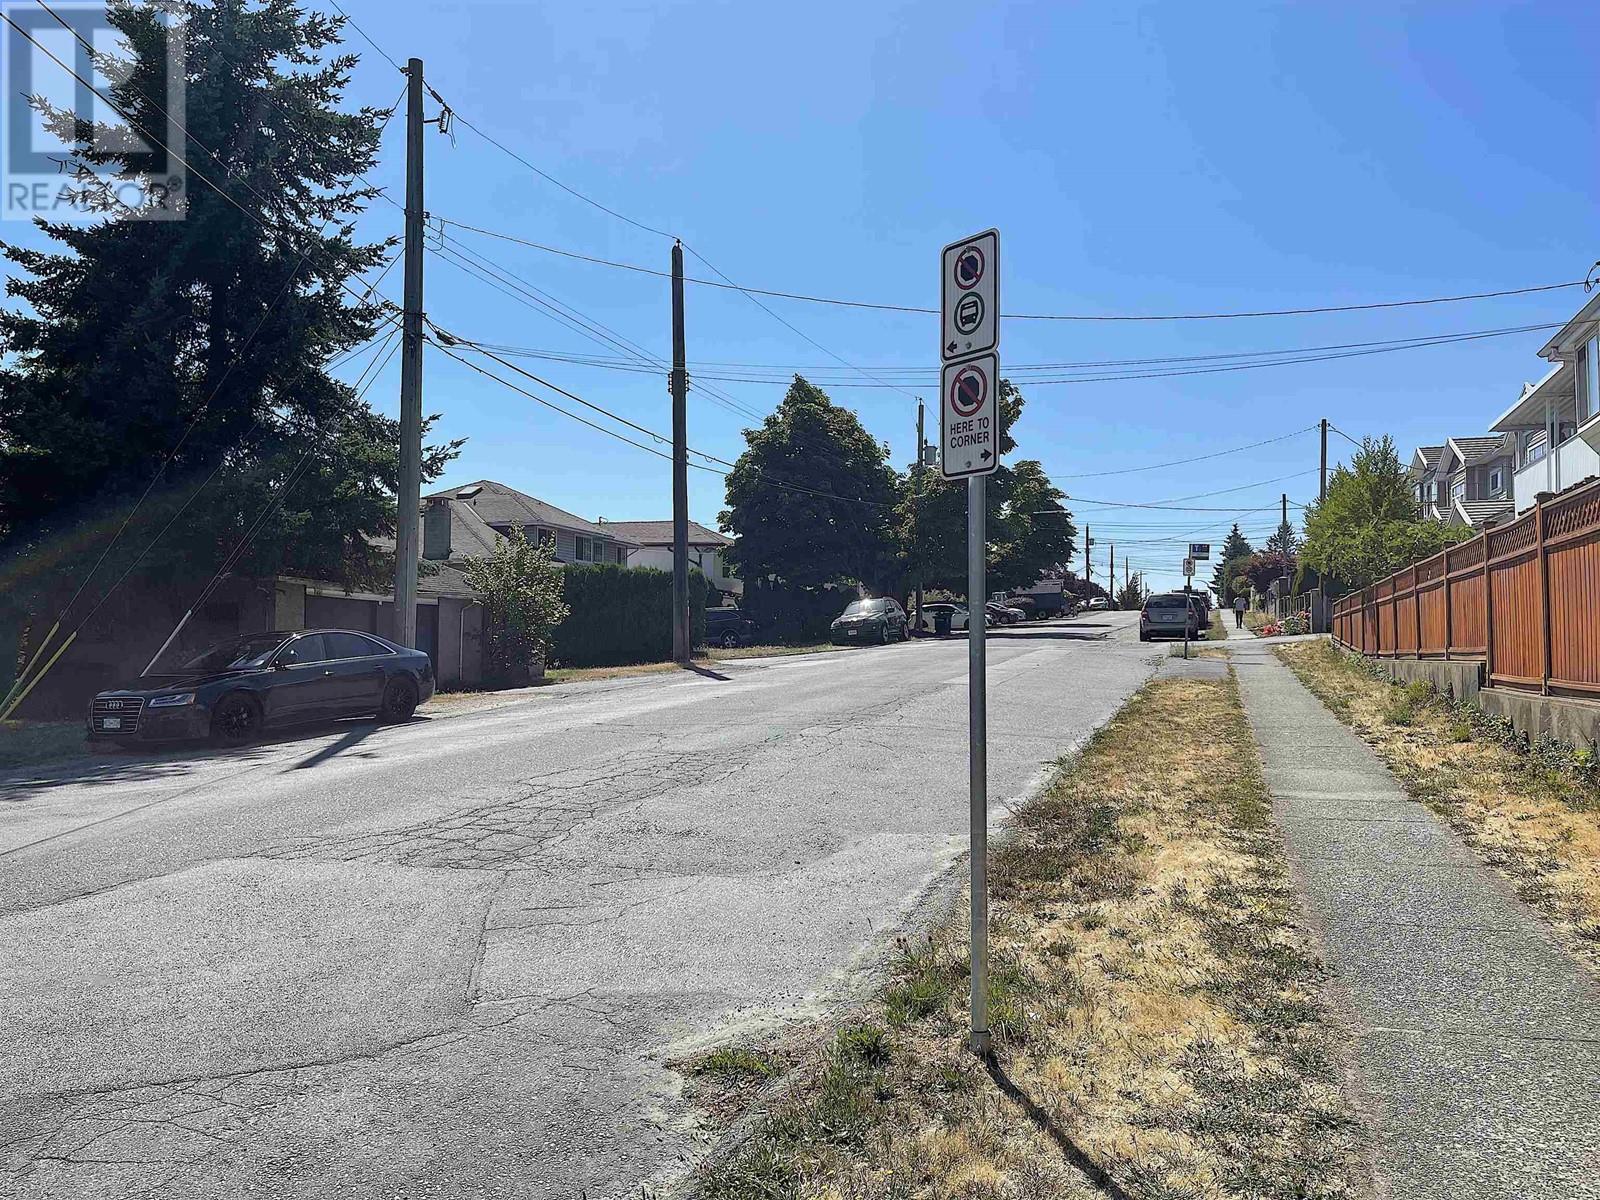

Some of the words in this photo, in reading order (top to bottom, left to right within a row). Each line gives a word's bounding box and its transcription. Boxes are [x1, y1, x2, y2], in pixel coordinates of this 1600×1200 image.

[950, 419, 974, 435] HERE
[977, 416, 990, 430] TO
[950, 431, 990, 449] CORNER
